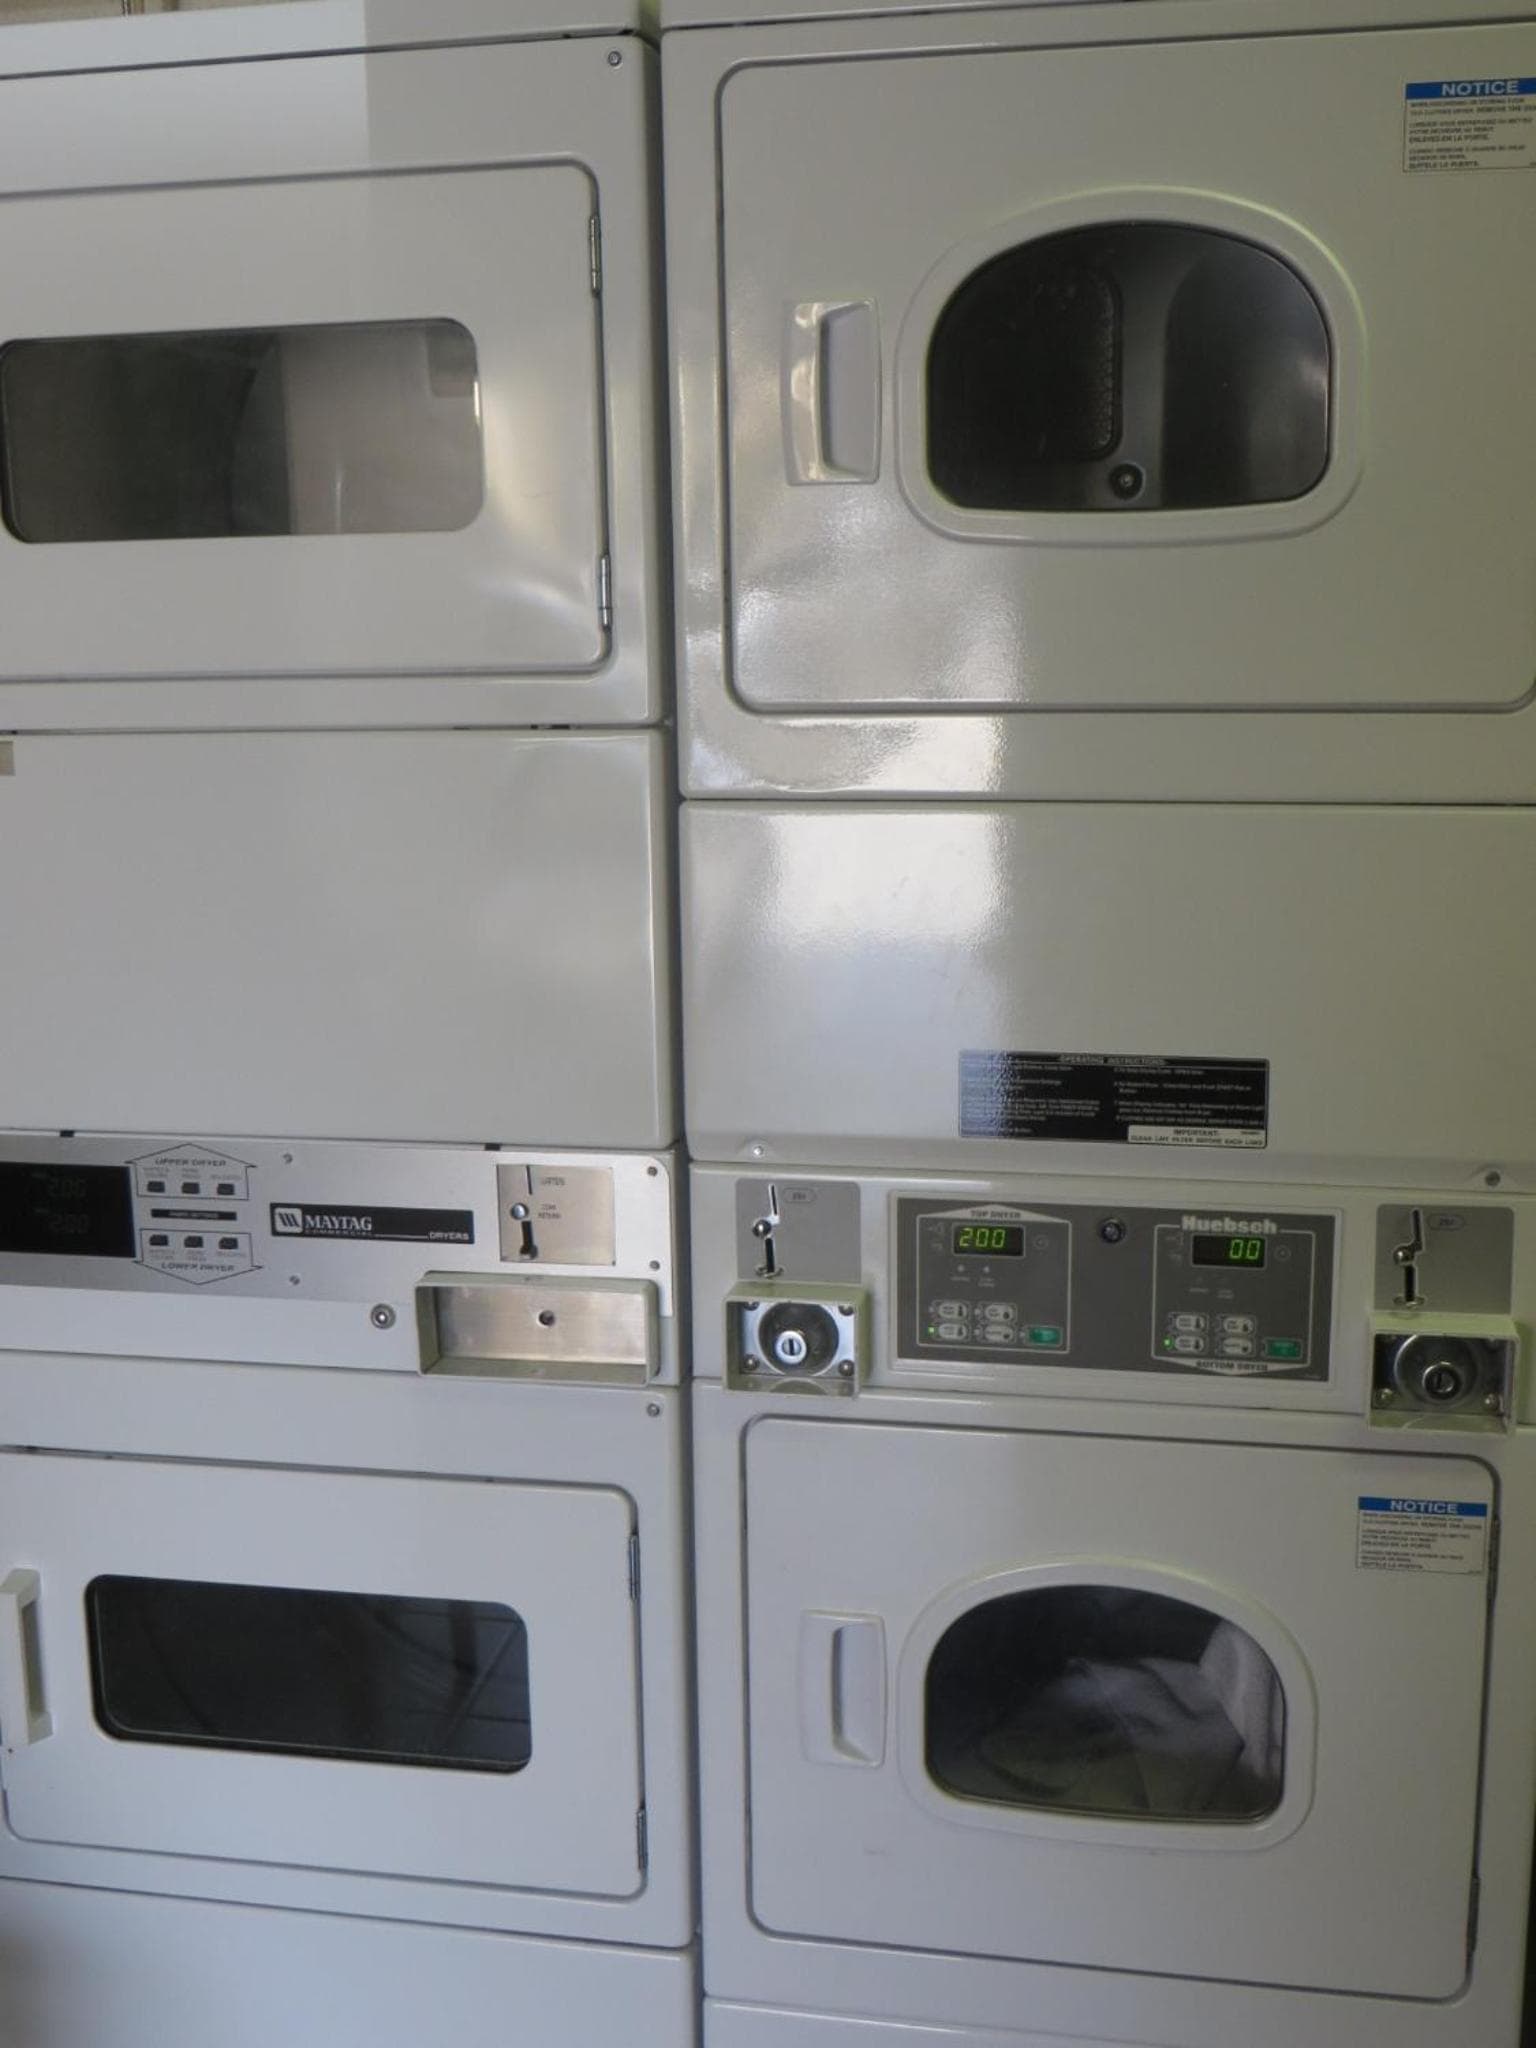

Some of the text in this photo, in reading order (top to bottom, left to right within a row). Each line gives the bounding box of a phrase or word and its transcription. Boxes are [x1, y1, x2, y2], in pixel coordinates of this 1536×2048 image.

[1441, 80, 1519, 96] NOTICE
[155, 1157, 227, 1167] UPPER DRYER
[305, 1214, 373, 1231] MAYTAG
[1181, 1215, 1278, 1234] Huebsch
[428, 1231, 470, 1241] DRYERS
[959, 1228, 1006, 1248] 200
[1229, 1239, 1261, 1260] 00
[161, 1261, 235, 1272] LOWER DRYER
[1195, 1359, 1235, 1369] BOTTOM
[1390, 1500, 1459, 1514] NOTICE
